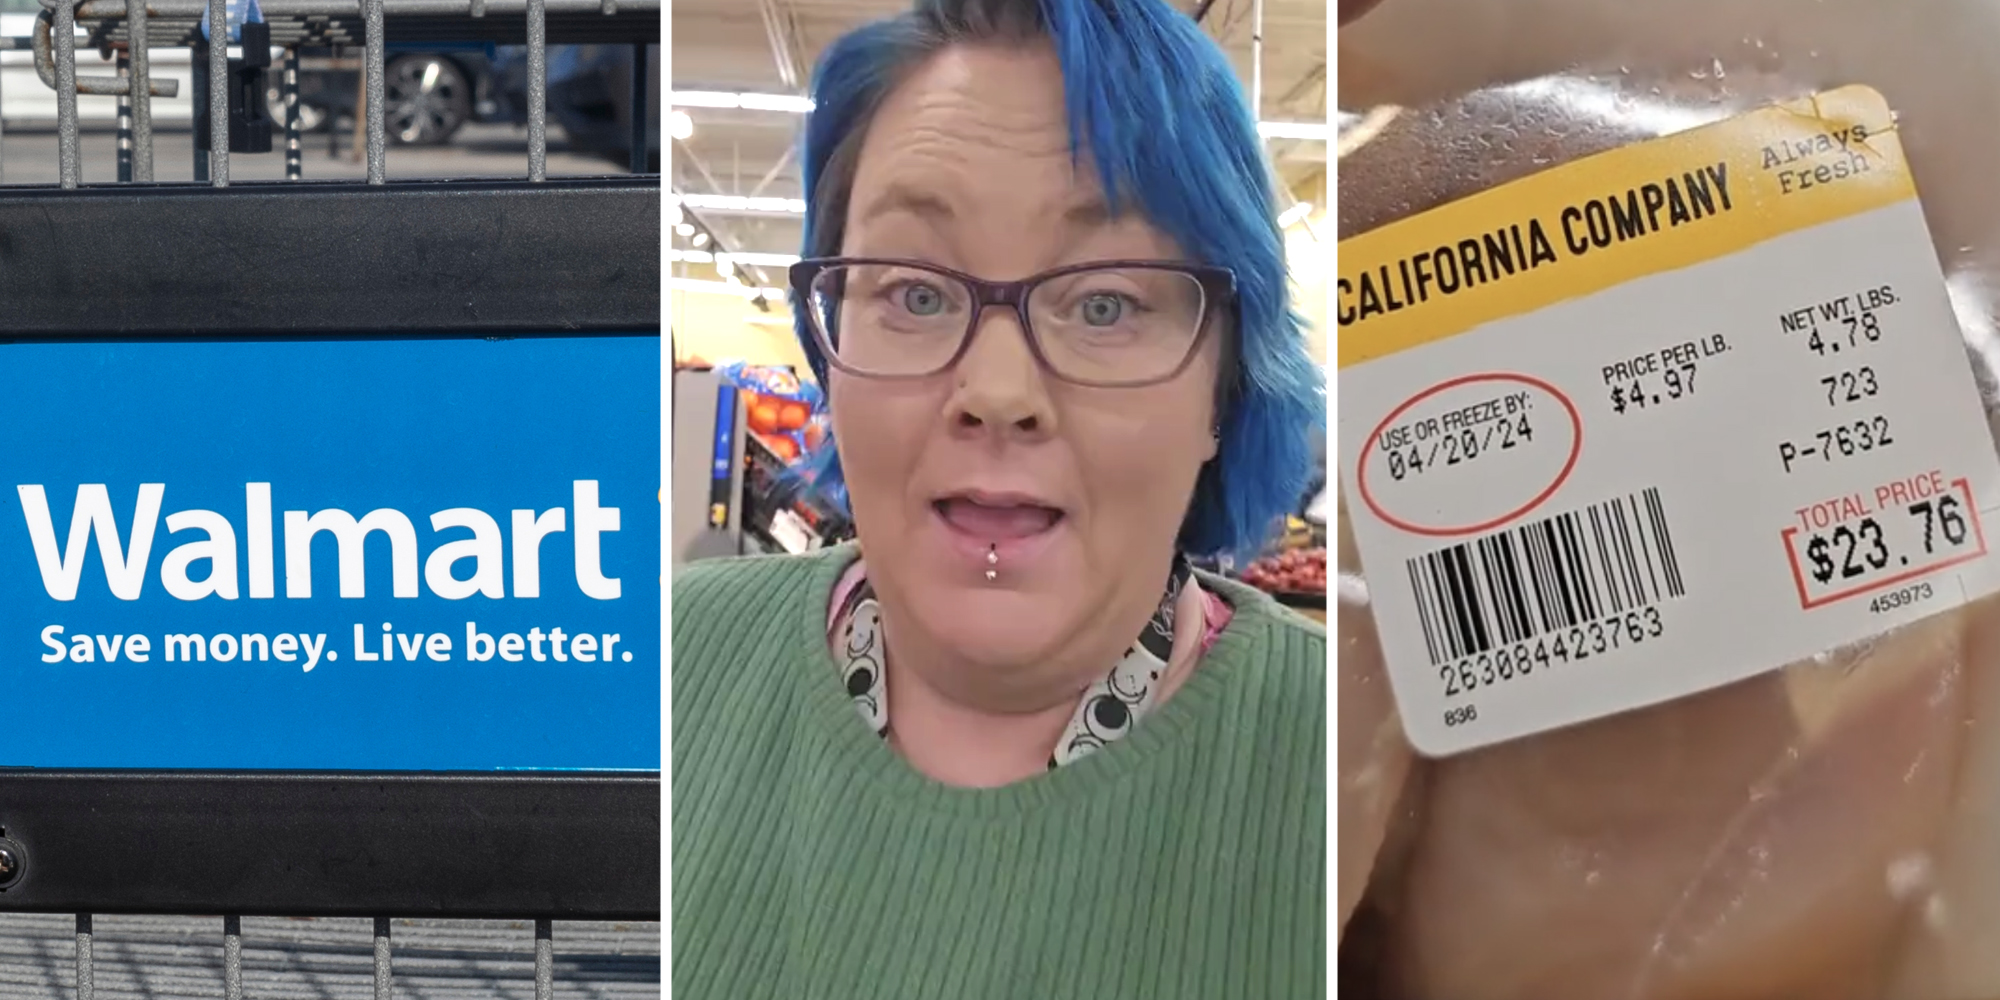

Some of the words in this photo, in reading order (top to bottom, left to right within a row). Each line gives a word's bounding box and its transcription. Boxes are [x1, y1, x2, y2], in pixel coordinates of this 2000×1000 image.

[1762, 124, 1867, 169] Always
[1778, 150, 1869, 194] Fresh
[1337, 218, 1556, 326] CALIFORNIA
[1561, 162, 1732, 255] COMPANY
[1780, 306, 1815, 333] NET
[1819, 297, 1855, 321] WT.
[1857, 286, 1901, 311] LBS.
[1809, 312, 1880, 356] 4.78
[1602, 353, 1658, 385] PRICE
[1661, 342, 1699, 368] PER
[1701, 334, 1732, 356] LB.
[1611, 363, 1696, 415] $4.97
[1821, 366, 1878, 406] 723
[1379, 426, 1412, 451] USE
[1415, 418, 1440, 440] OR
[1442, 399, 1502, 432] FREEZE
[1504, 391, 1533, 414] BY:
[1388, 413, 1532, 480] 04/20/24
[1780, 416, 1893, 473] P-7632
[1796, 493, 1872, 531] TOTAL
[1874, 470, 1945, 509] PRICE
[17, 480, 622, 601] Walmart
[1807, 495, 1966, 585] $23.76
[1870, 582, 1933, 613] 453973
[40, 625, 150, 663] Save
[164, 632, 338, 672] money.
[354, 623, 452, 662] Live
[466, 621, 633, 662] better.
[1440, 607, 1663, 696] 263084423763
[1444, 704, 1477, 726] 836
